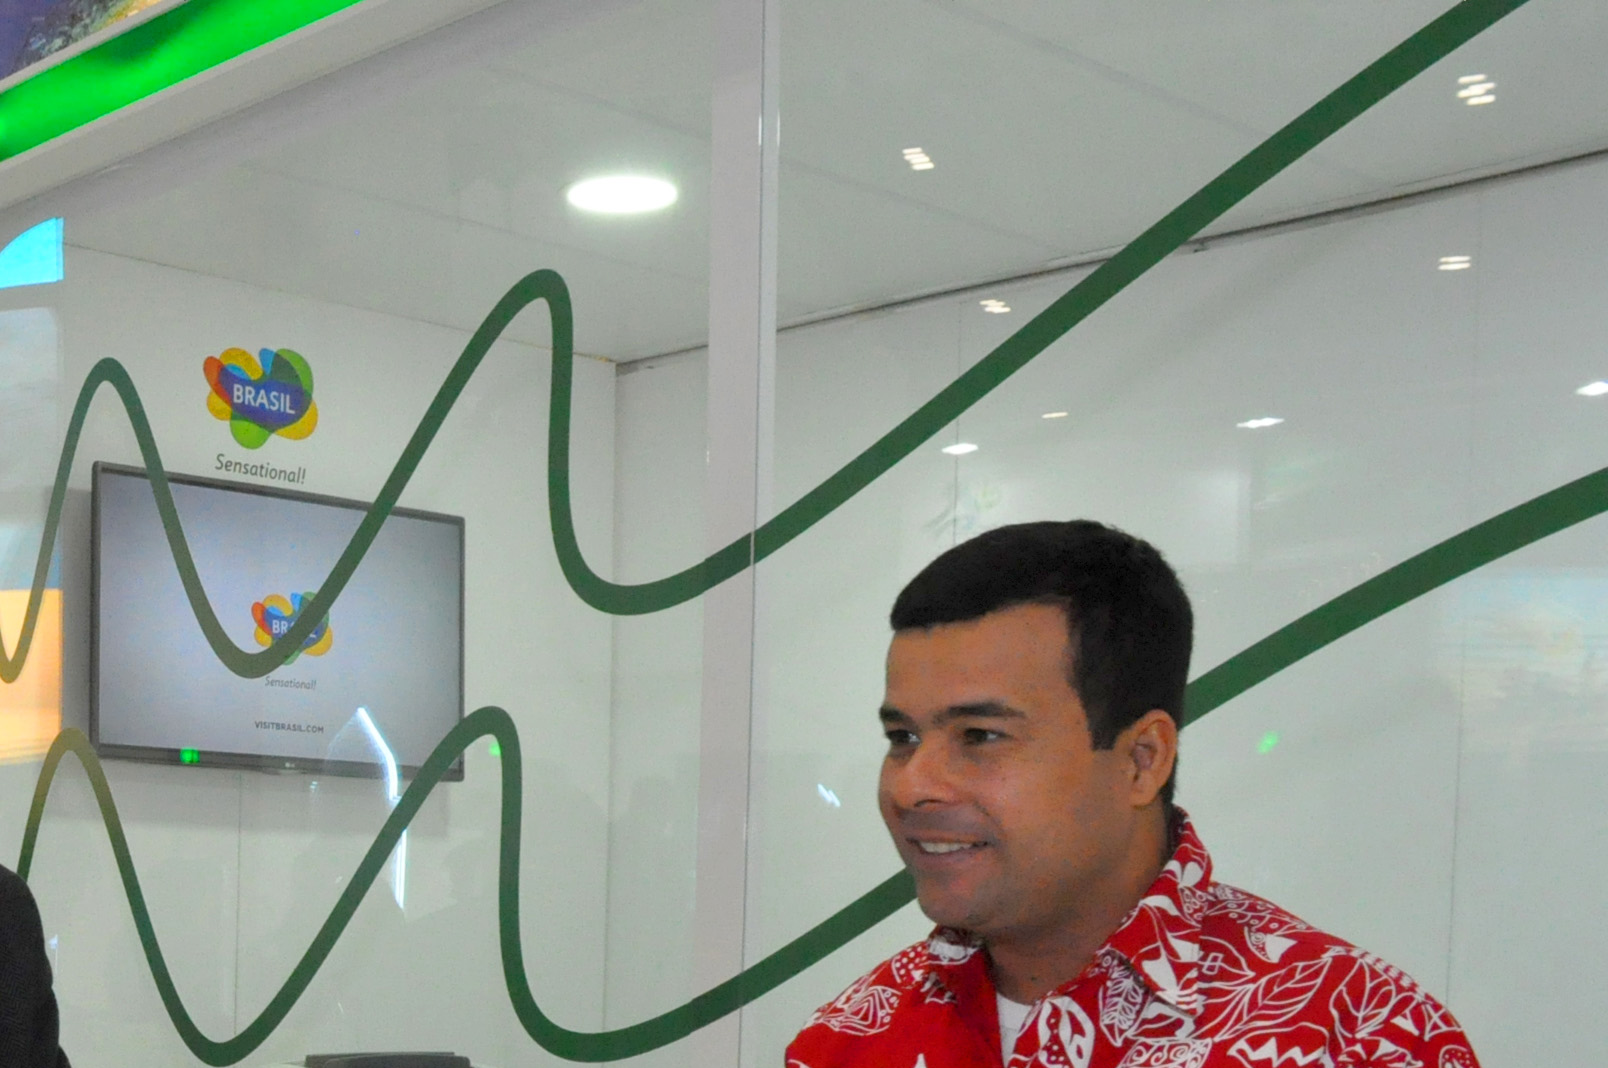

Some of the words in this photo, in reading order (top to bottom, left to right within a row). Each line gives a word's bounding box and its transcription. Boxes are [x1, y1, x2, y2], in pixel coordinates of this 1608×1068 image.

[233, 384, 295, 414] BRASIL
[215, 453, 306, 484] Sensational!
[265, 675, 317, 690] Sensational!
[255, 721, 324, 733] VISITBRASIL.COM
